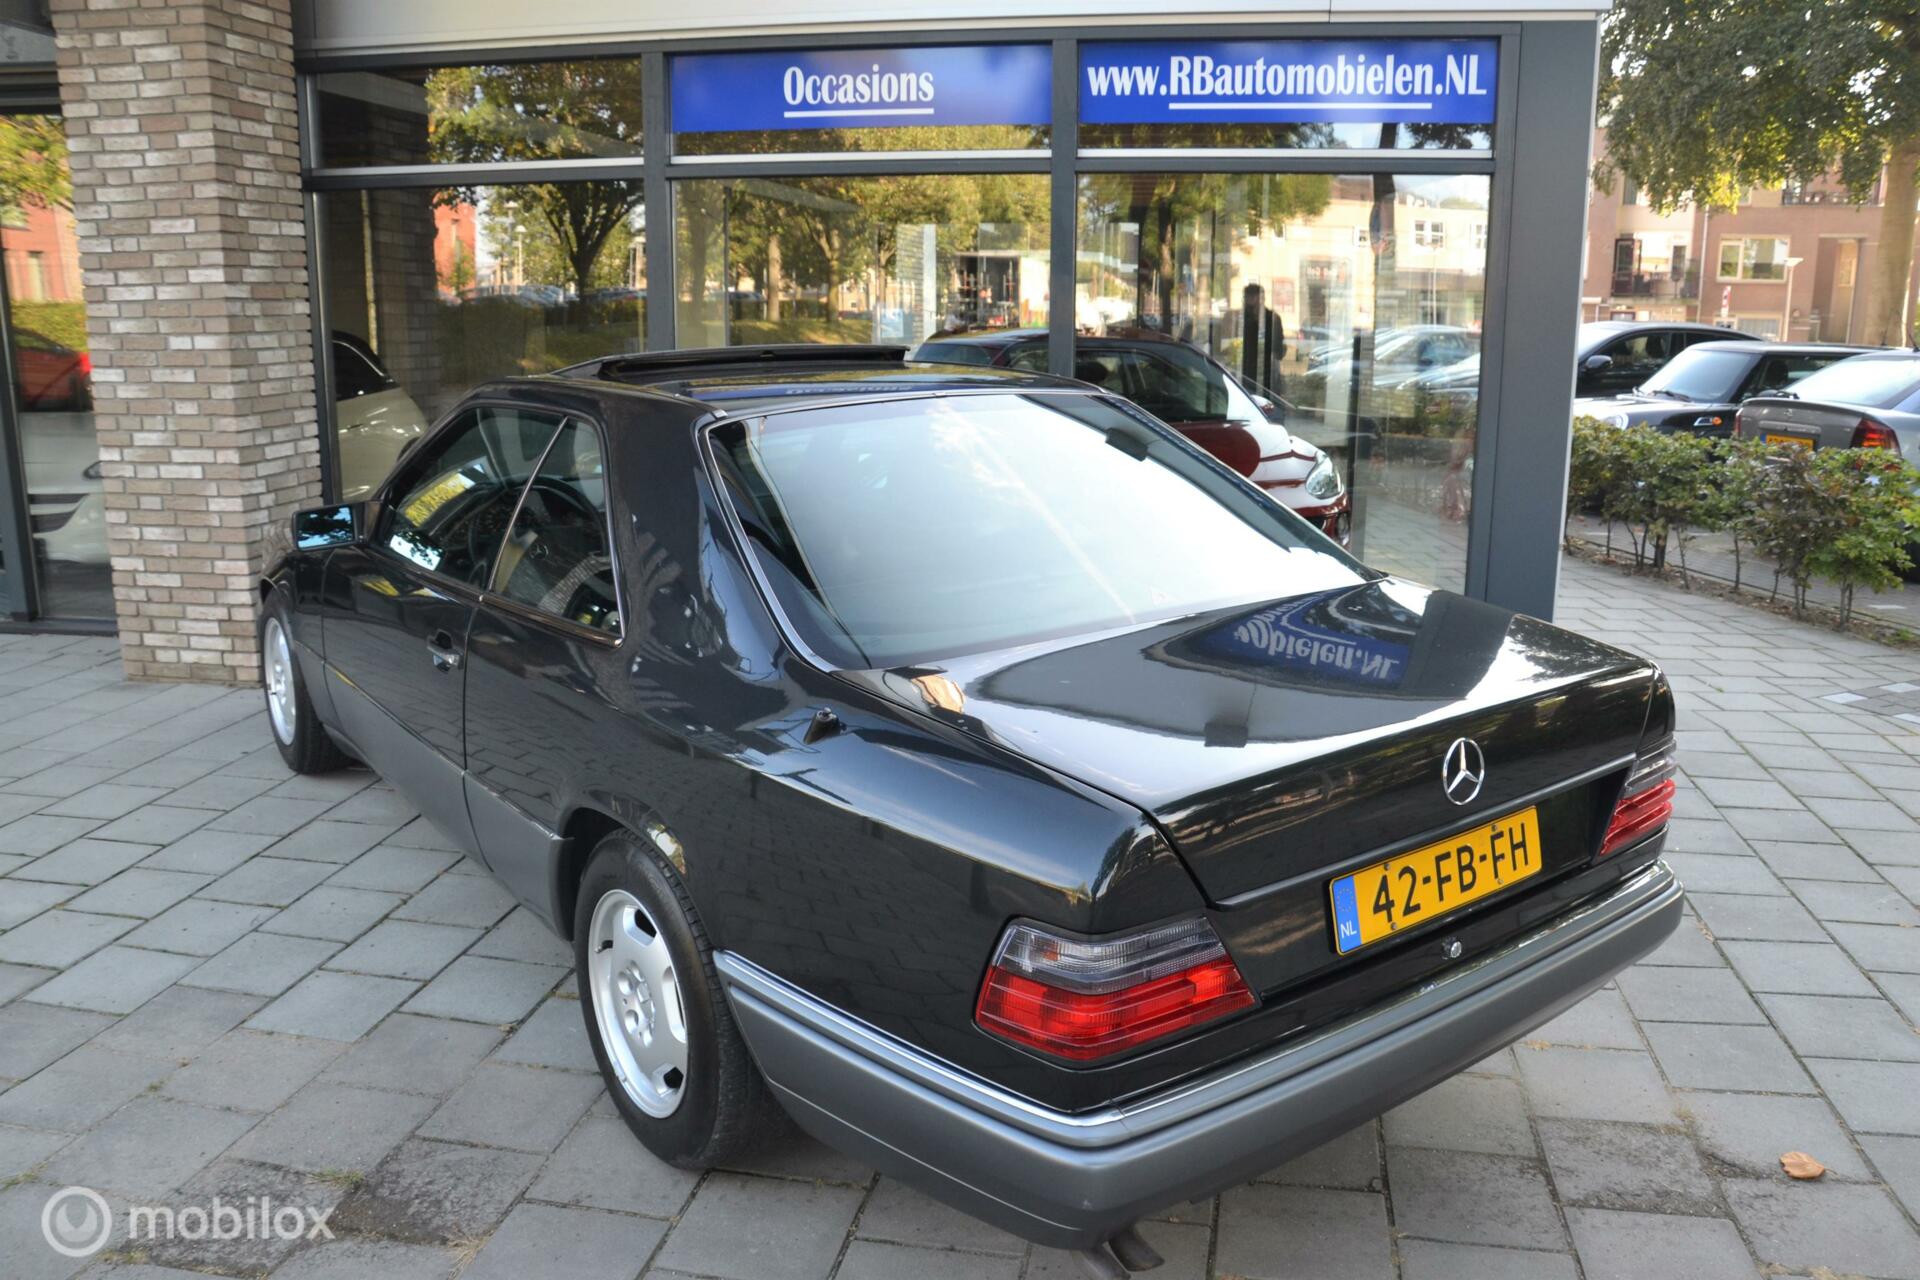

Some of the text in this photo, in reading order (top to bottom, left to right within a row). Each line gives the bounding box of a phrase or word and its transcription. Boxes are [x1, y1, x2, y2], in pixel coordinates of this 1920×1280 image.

[783, 63, 935, 106] Occasions
[1087, 54, 1487, 96] www.RBautomobielen.NL
[1372, 822, 1529, 923] 42-FB-FH
[1340, 919, 1358, 938] NL
